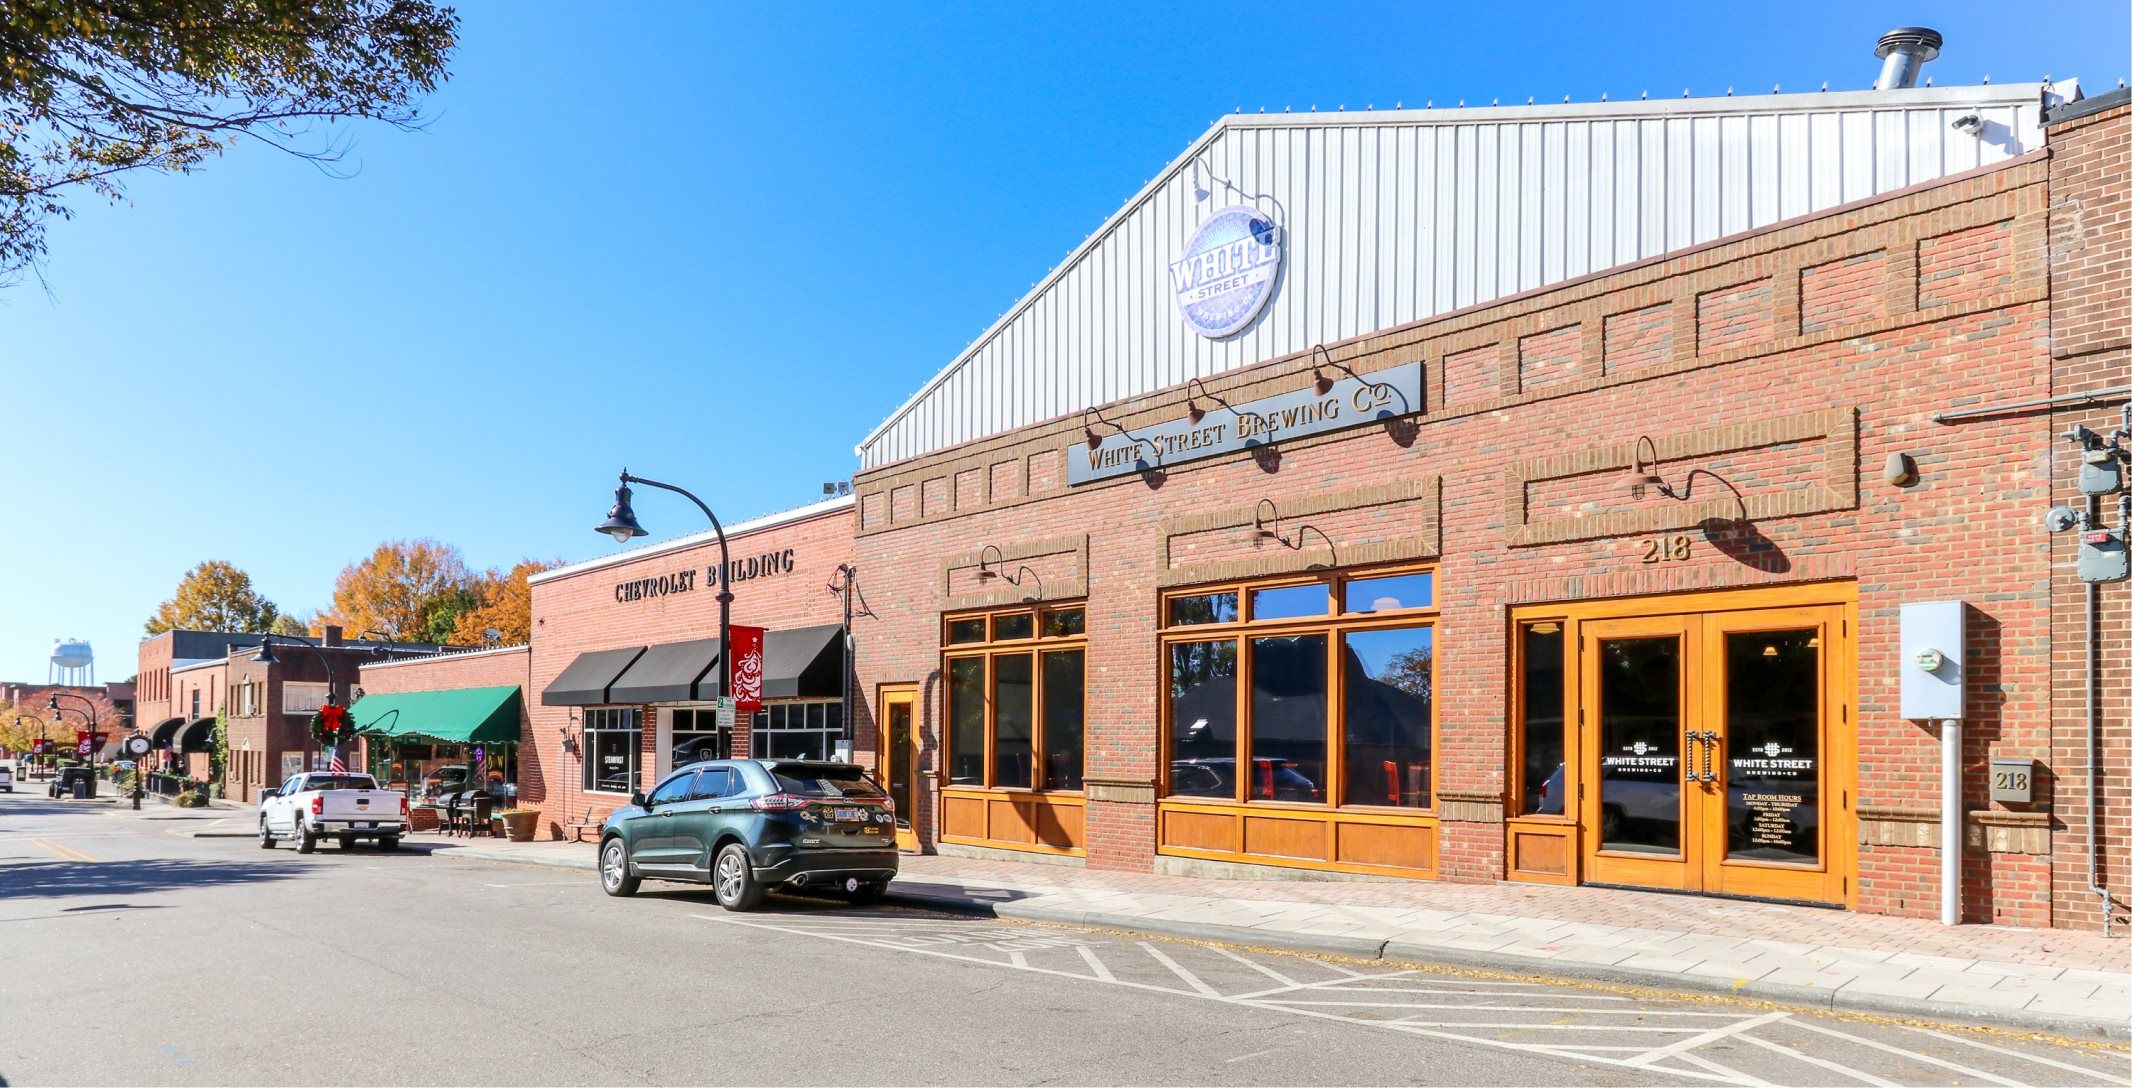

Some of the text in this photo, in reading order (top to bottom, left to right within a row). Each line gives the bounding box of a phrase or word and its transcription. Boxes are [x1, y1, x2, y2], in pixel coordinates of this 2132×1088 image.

[1170, 227, 1276, 292] WHITE
[1197, 274, 1249, 299] STREET
[1087, 443, 1143, 470] WHITE
[1152, 424, 1227, 458] STREET
[1236, 397, 1339, 439] BREWING
[1641, 534, 1691, 564] 218
[614, 569, 696, 602] CHEVROLET
[1607, 757, 1675, 766] WHITE STREET
[1733, 759, 1813, 769] WHITE STREET
[1996, 772, 2027, 790] 218
